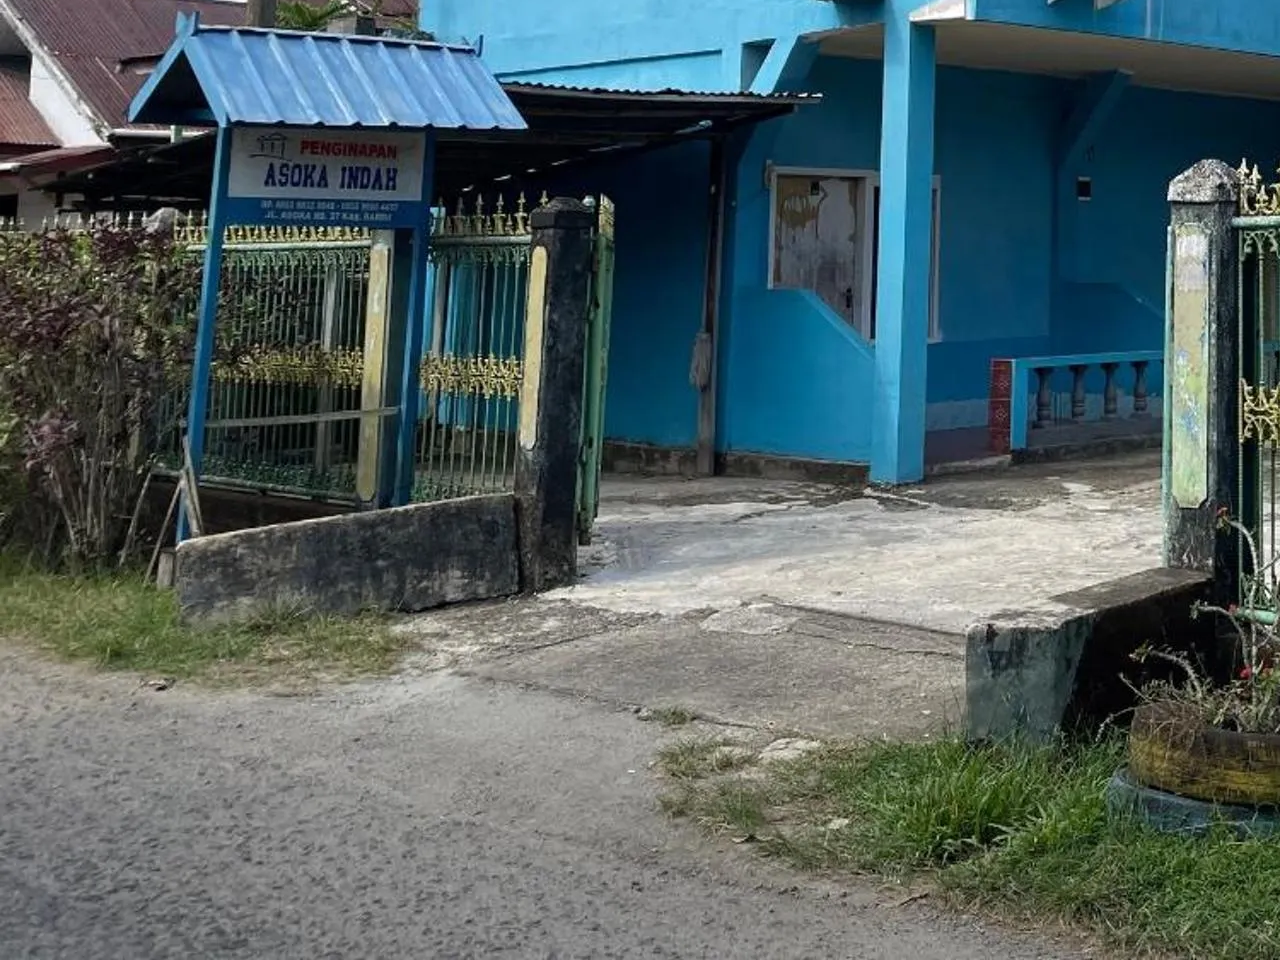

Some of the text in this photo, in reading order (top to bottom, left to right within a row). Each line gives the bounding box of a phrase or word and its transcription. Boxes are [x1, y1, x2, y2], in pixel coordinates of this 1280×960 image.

[300, 139, 398, 159] PENGINAPAN
[264, 162, 399, 191] ASOKA INDAH
